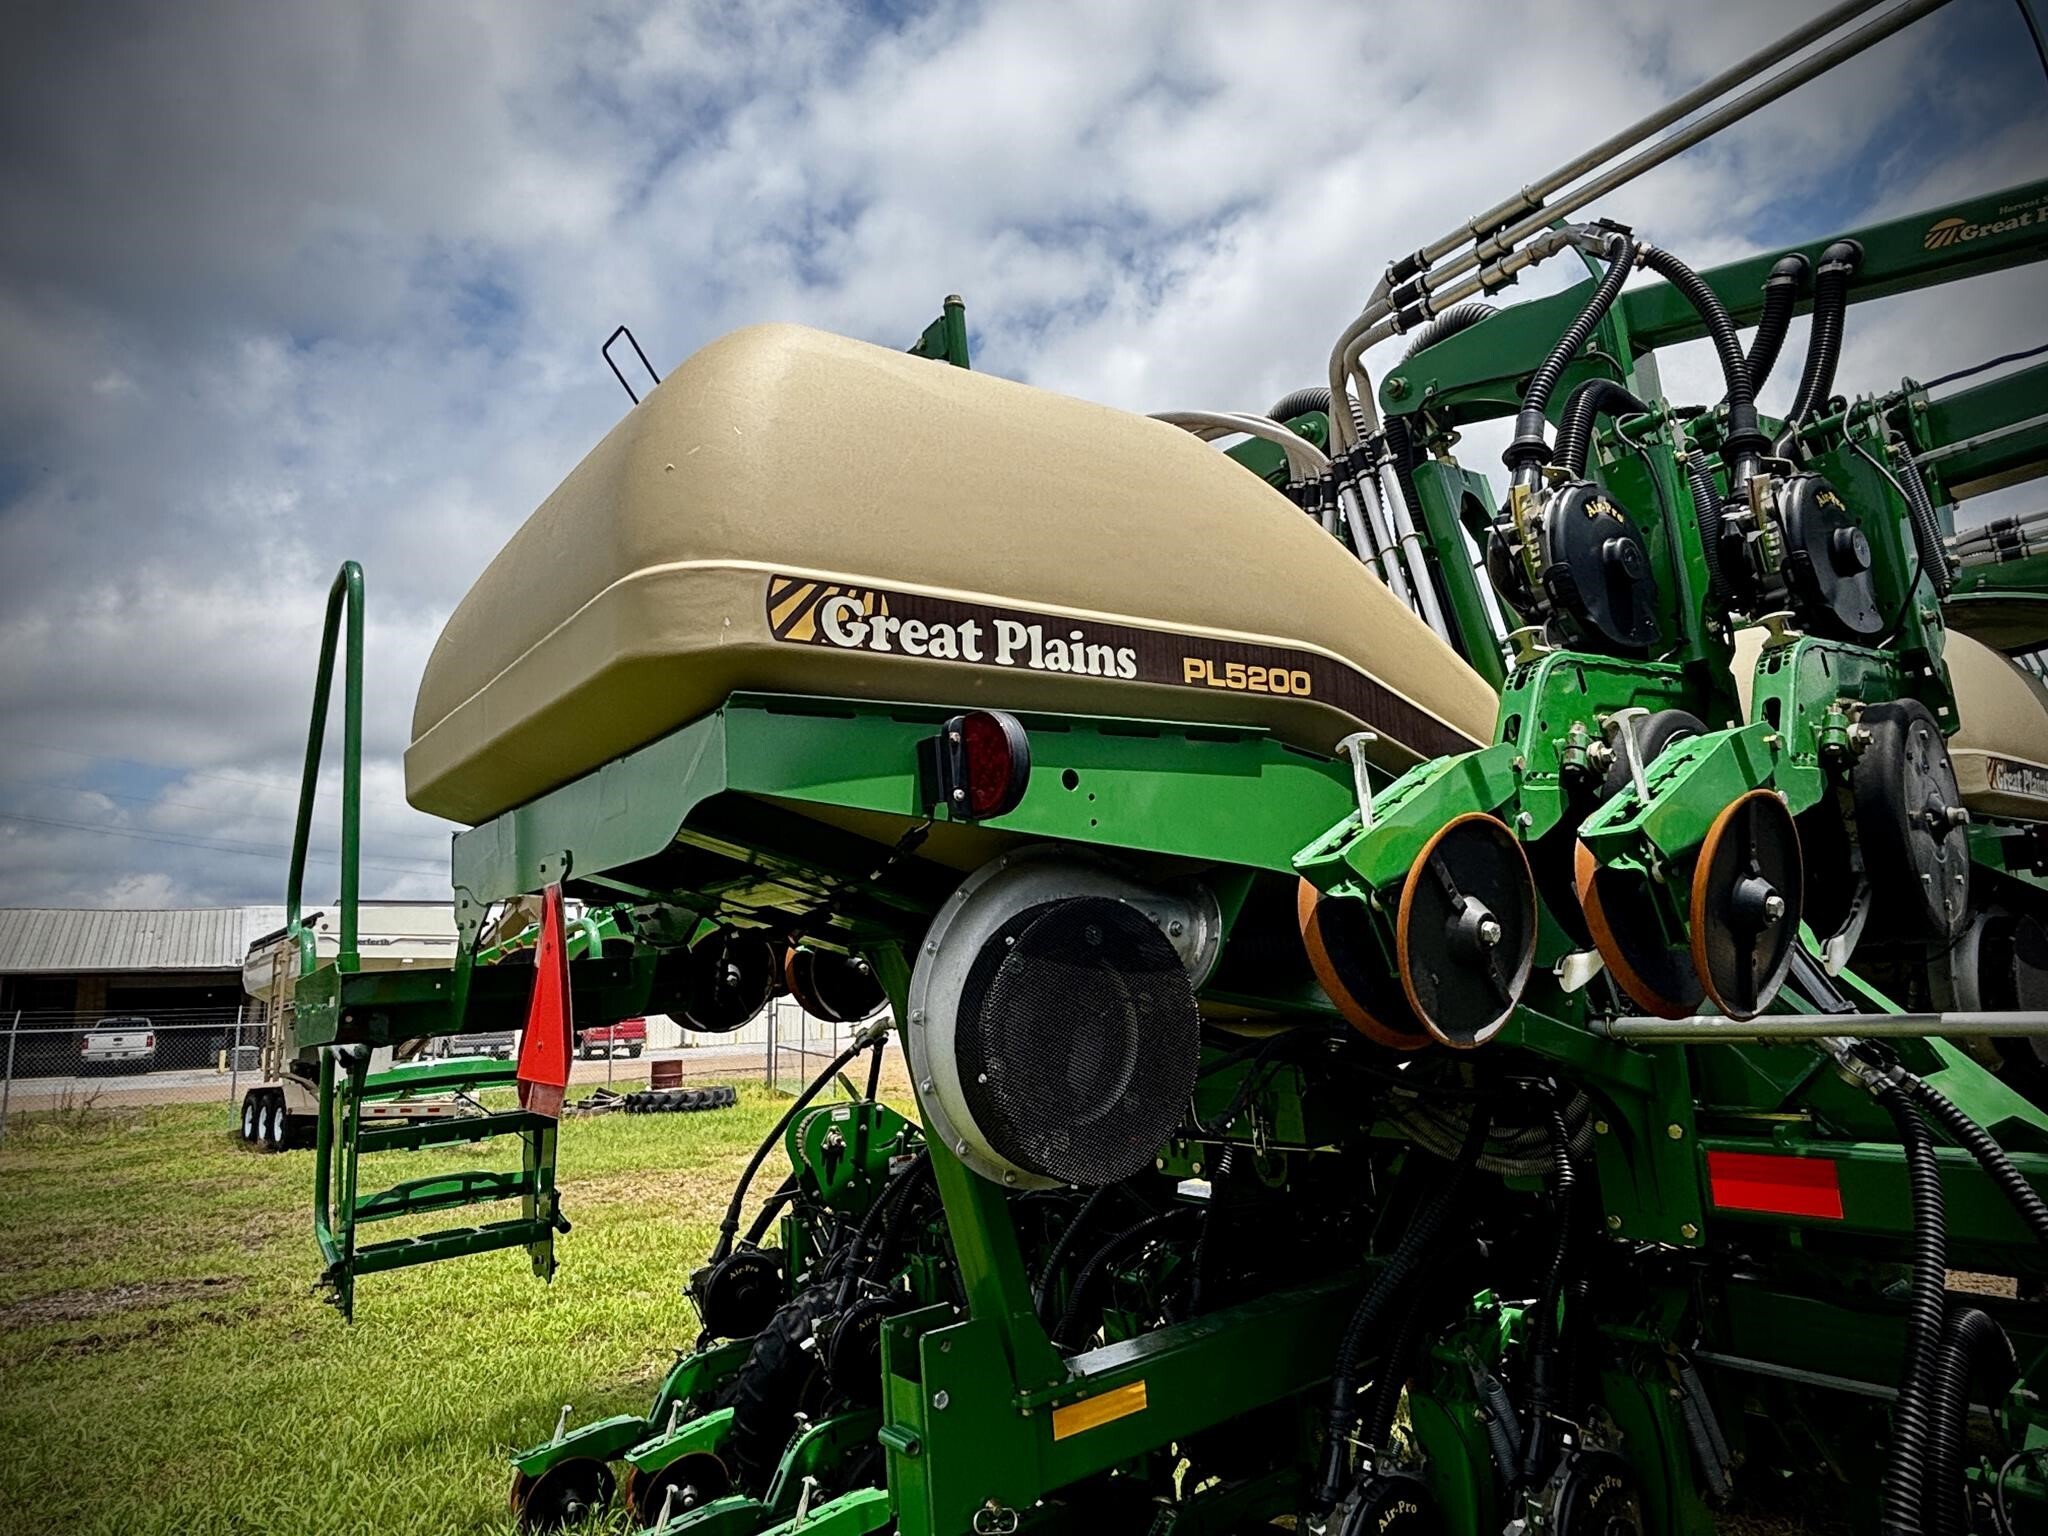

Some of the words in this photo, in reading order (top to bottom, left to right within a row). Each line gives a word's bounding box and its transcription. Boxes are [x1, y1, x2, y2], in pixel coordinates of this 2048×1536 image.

[1959, 211, 2033, 241] Great
[821, 595, 983, 662] Great
[992, 619, 1138, 679] Plains
[1182, 656, 1312, 697] PL5200
[1996, 764, 2023, 792] Great
[1378, 1500, 1417, 1534] Air-Pro
